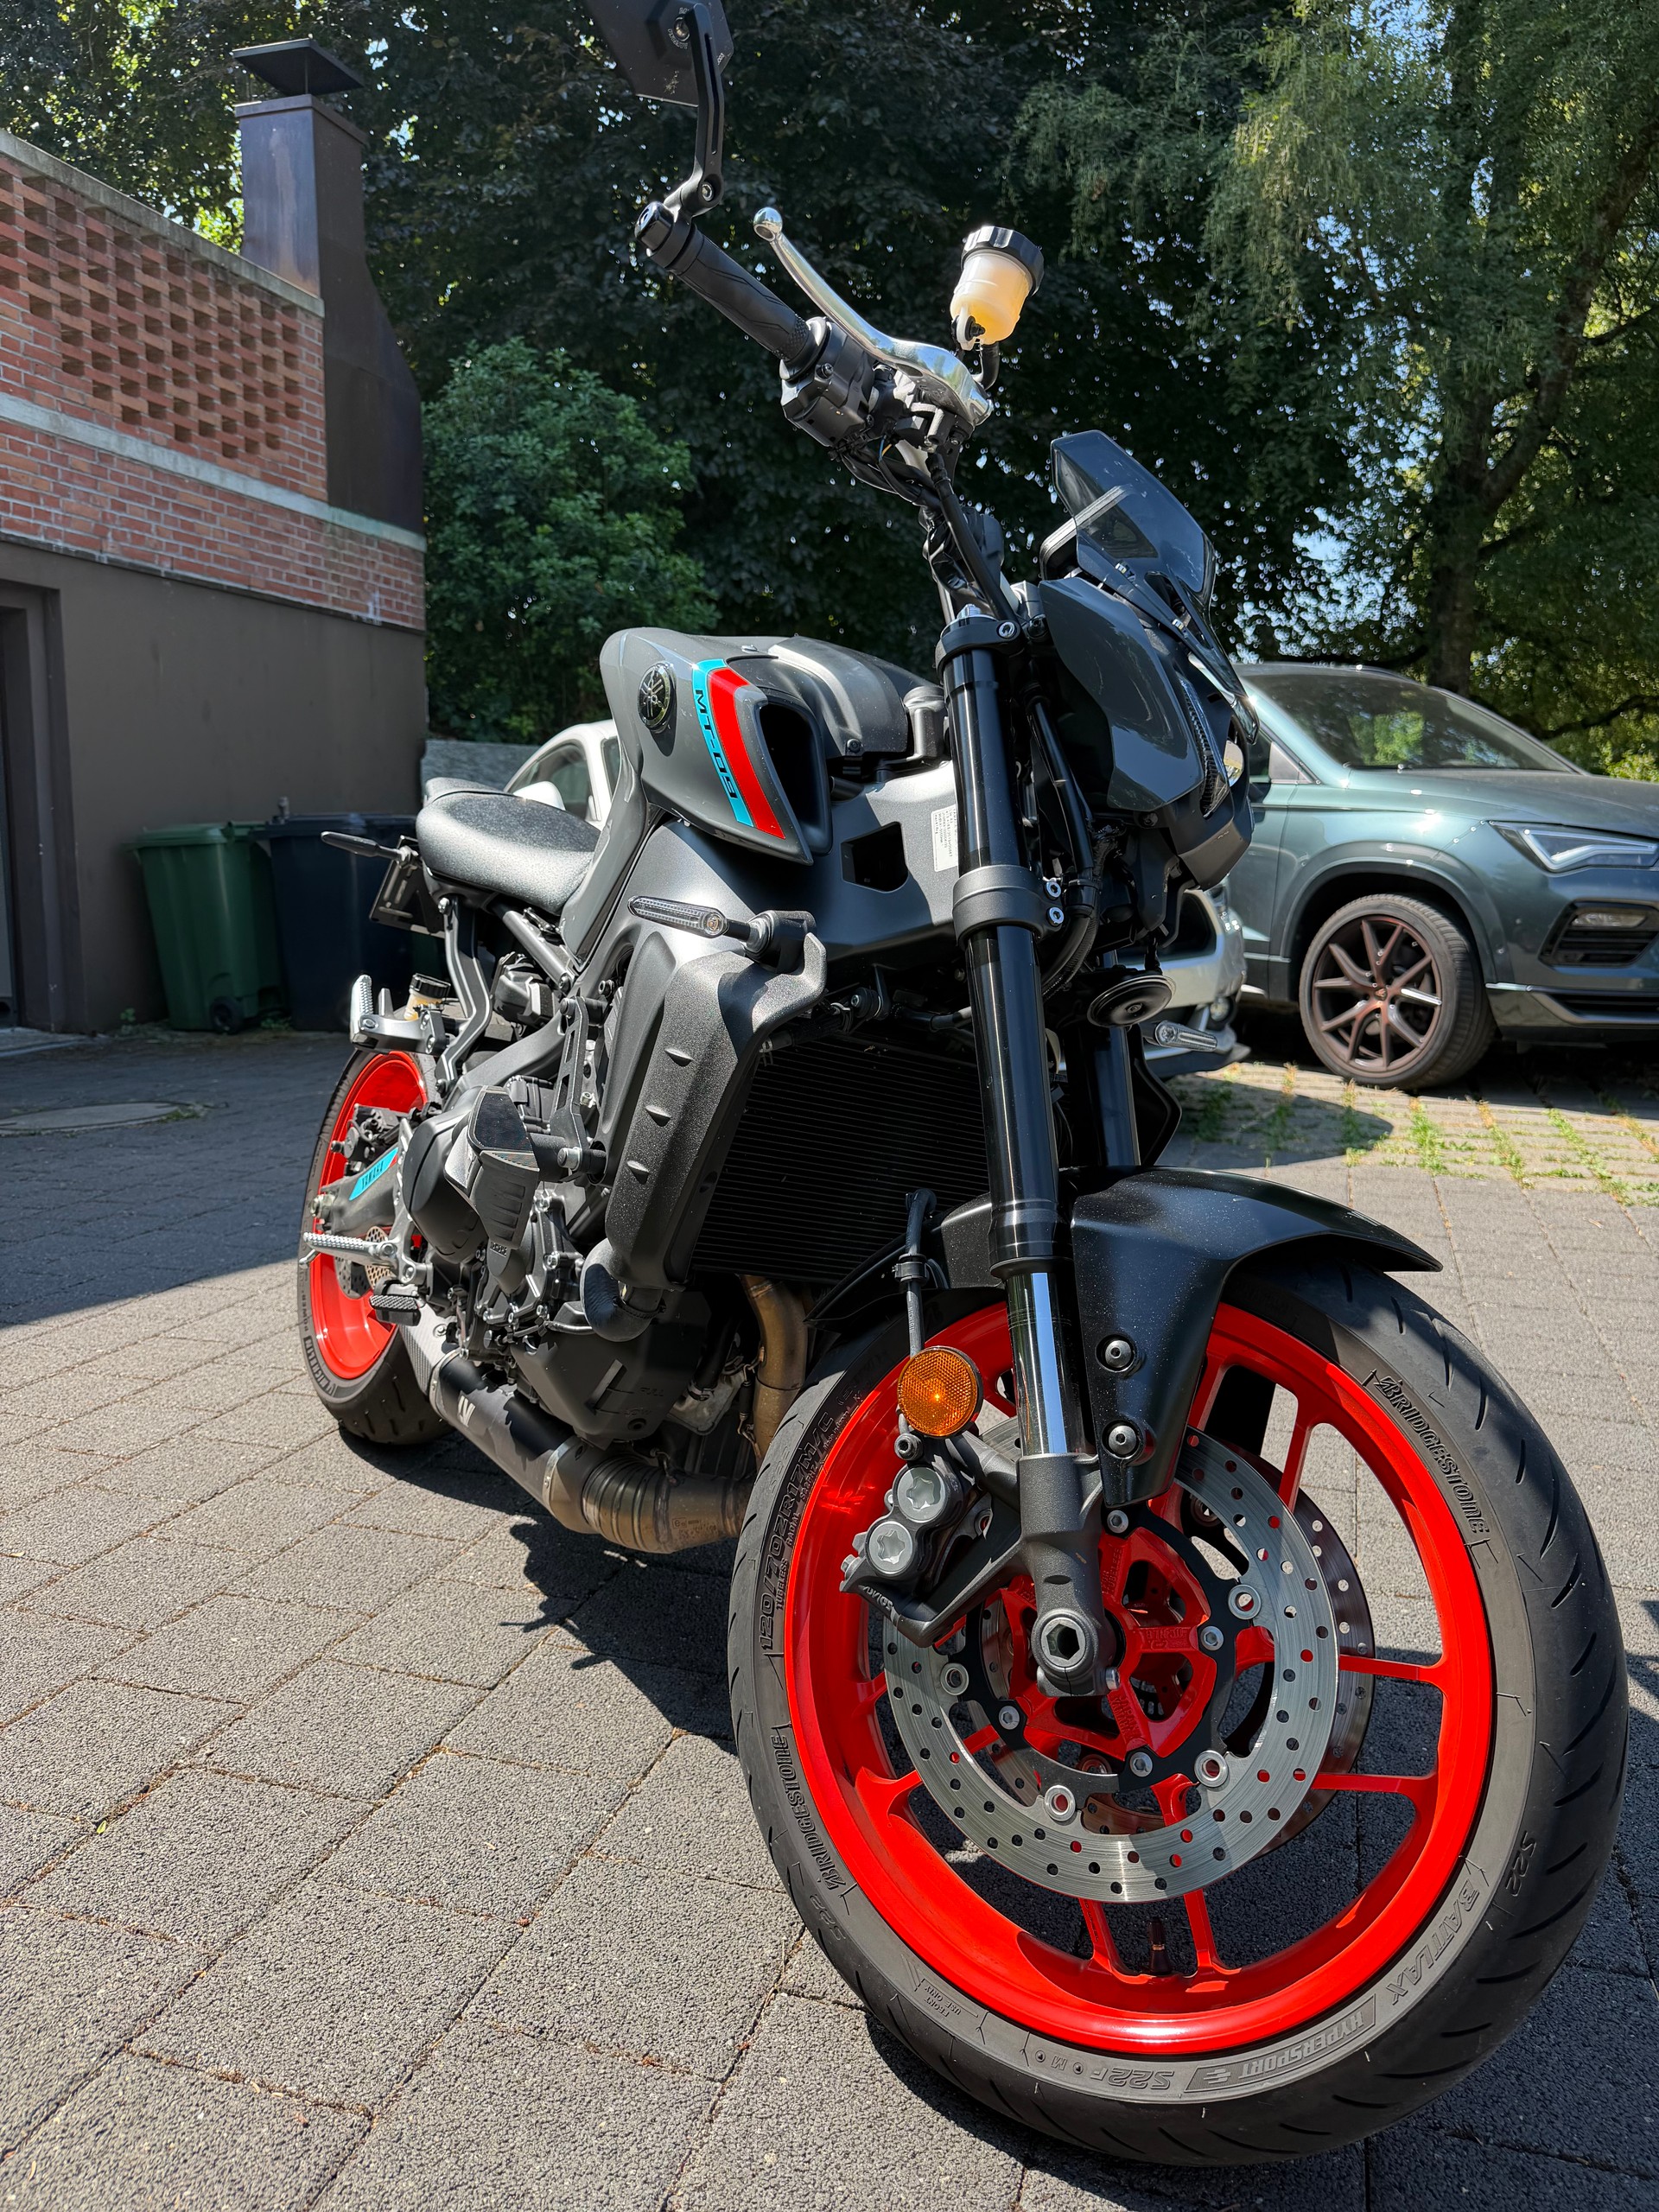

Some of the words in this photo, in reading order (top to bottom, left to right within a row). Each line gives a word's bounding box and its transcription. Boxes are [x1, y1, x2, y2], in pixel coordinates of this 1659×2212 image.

[695, 689, 739, 799] MT-09
[303, 1336, 329, 1388] MICHELIN
[1374, 1375, 1490, 1534] BRIDGESTONE
[776, 1557, 789, 1611] TUBELESS
[785, 1510, 801, 1548] RADIAL
[770, 1734, 847, 1891] BRIDGESTONE
[1504, 1830, 1537, 1897] S22
[1386, 1878, 1481, 2006] BATTLAX
[923, 1996, 950, 2018] FRONT
[925, 1986, 944, 2002] ONLY
[944, 1999, 962, 2015] USE
[1237, 2009, 1365, 2079] HYPERSPORT
[1090, 2066, 1175, 2091] S22F
